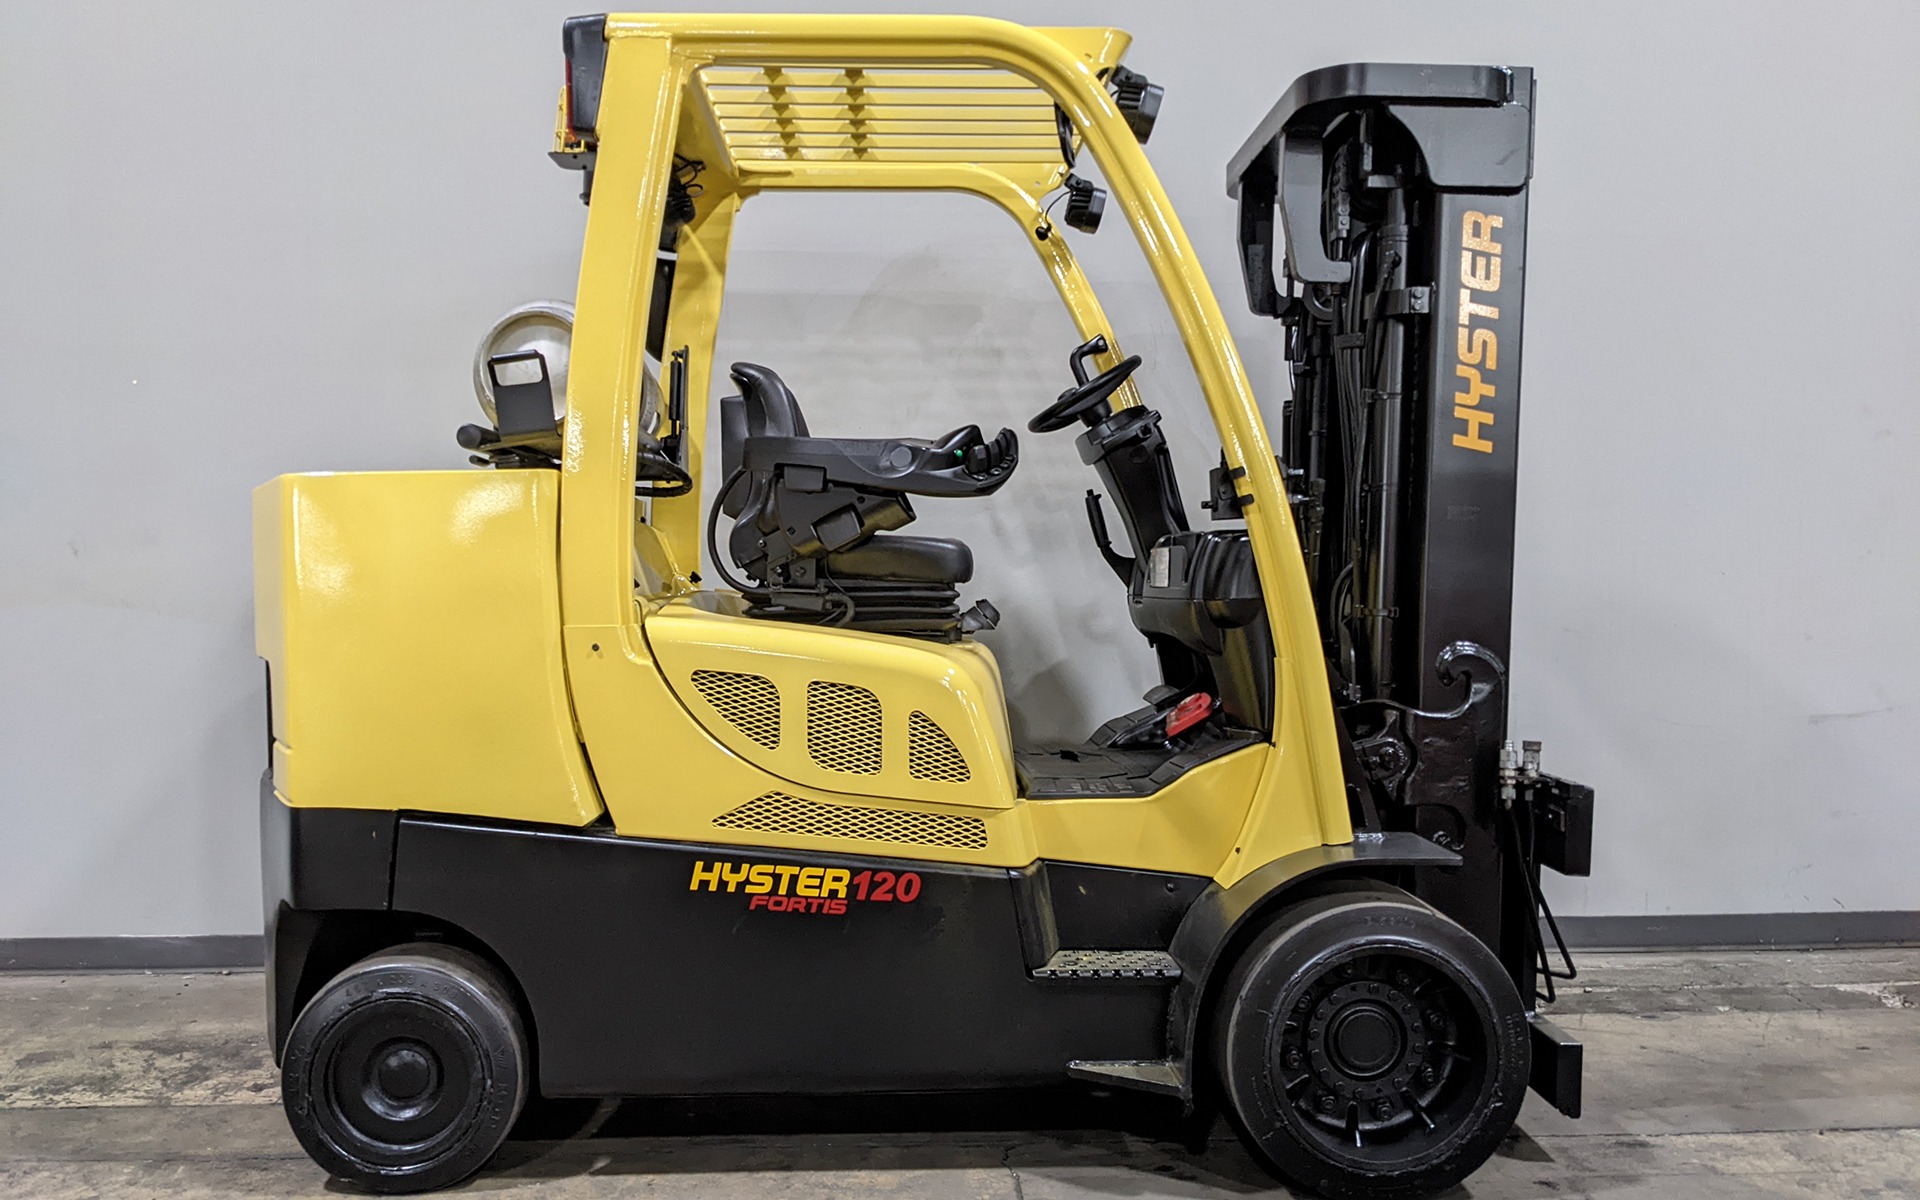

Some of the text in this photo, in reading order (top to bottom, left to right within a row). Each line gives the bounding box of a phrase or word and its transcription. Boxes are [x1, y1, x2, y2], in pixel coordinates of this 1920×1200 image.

[1452, 210, 1504, 454] HYSTER
[689, 861, 922, 903] HYSTER 120
[749, 895, 849, 915] FORTIS
